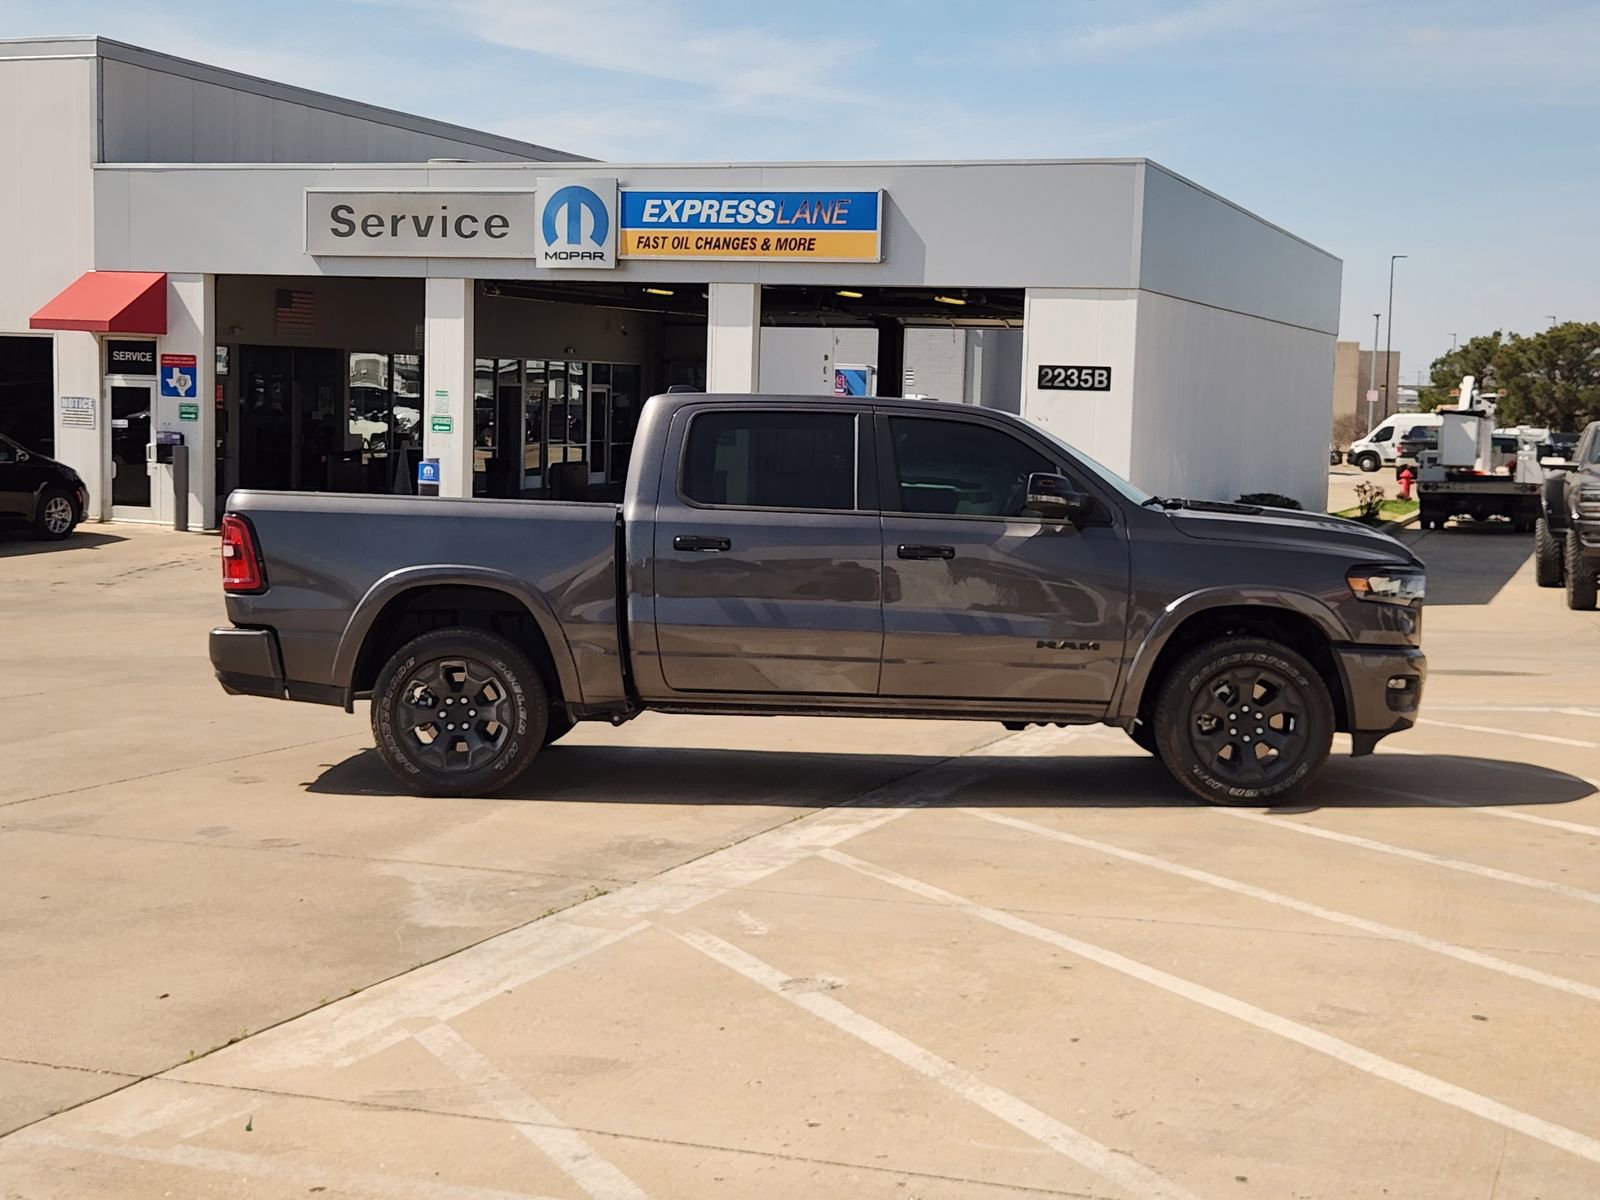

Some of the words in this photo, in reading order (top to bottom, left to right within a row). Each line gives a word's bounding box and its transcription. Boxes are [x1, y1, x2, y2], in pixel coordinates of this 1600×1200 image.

[330, 204, 510, 239] Service
[636, 235, 669, 249] FAST
[671, 236, 691, 250] OIL
[695, 237, 757, 251] CHANGES
[761, 238, 771, 251] &
[775, 238, 816, 251] MORE
[545, 251, 606, 262] MOPAR
[112, 351, 152, 362] SERVICE
[1040, 368, 1108, 388] 2235B
[1036, 640, 1100, 651] RAM
